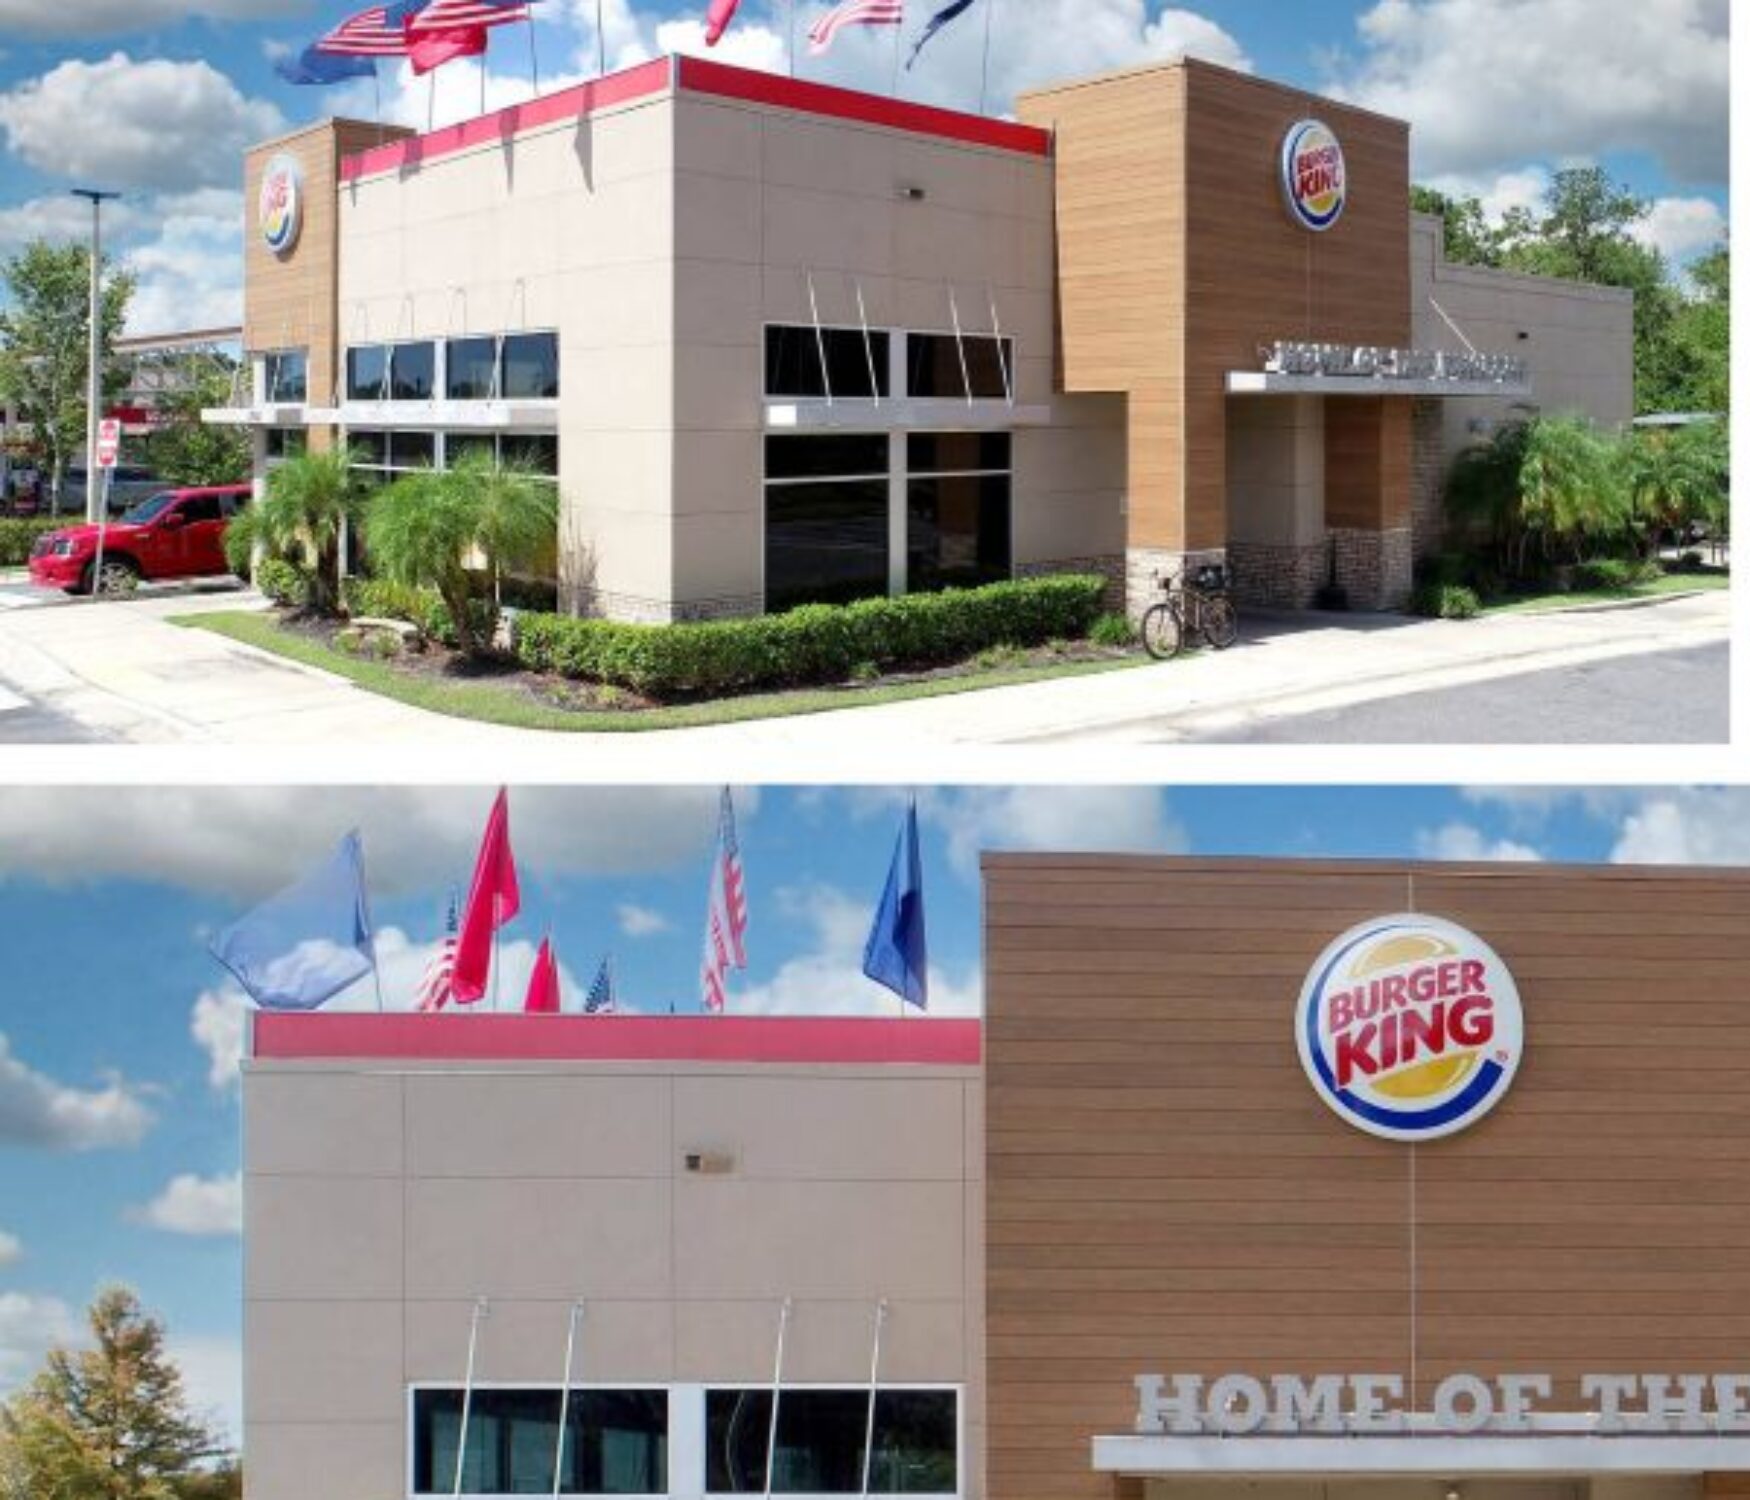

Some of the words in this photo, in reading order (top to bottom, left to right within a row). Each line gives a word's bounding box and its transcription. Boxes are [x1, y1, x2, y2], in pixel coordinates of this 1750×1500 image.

[1329, 960, 1486, 1034] BURGER
[1336, 996, 1494, 1087] KING
[1135, 1374, 1404, 1434] HOME
[1434, 1373, 1552, 1433] OF
